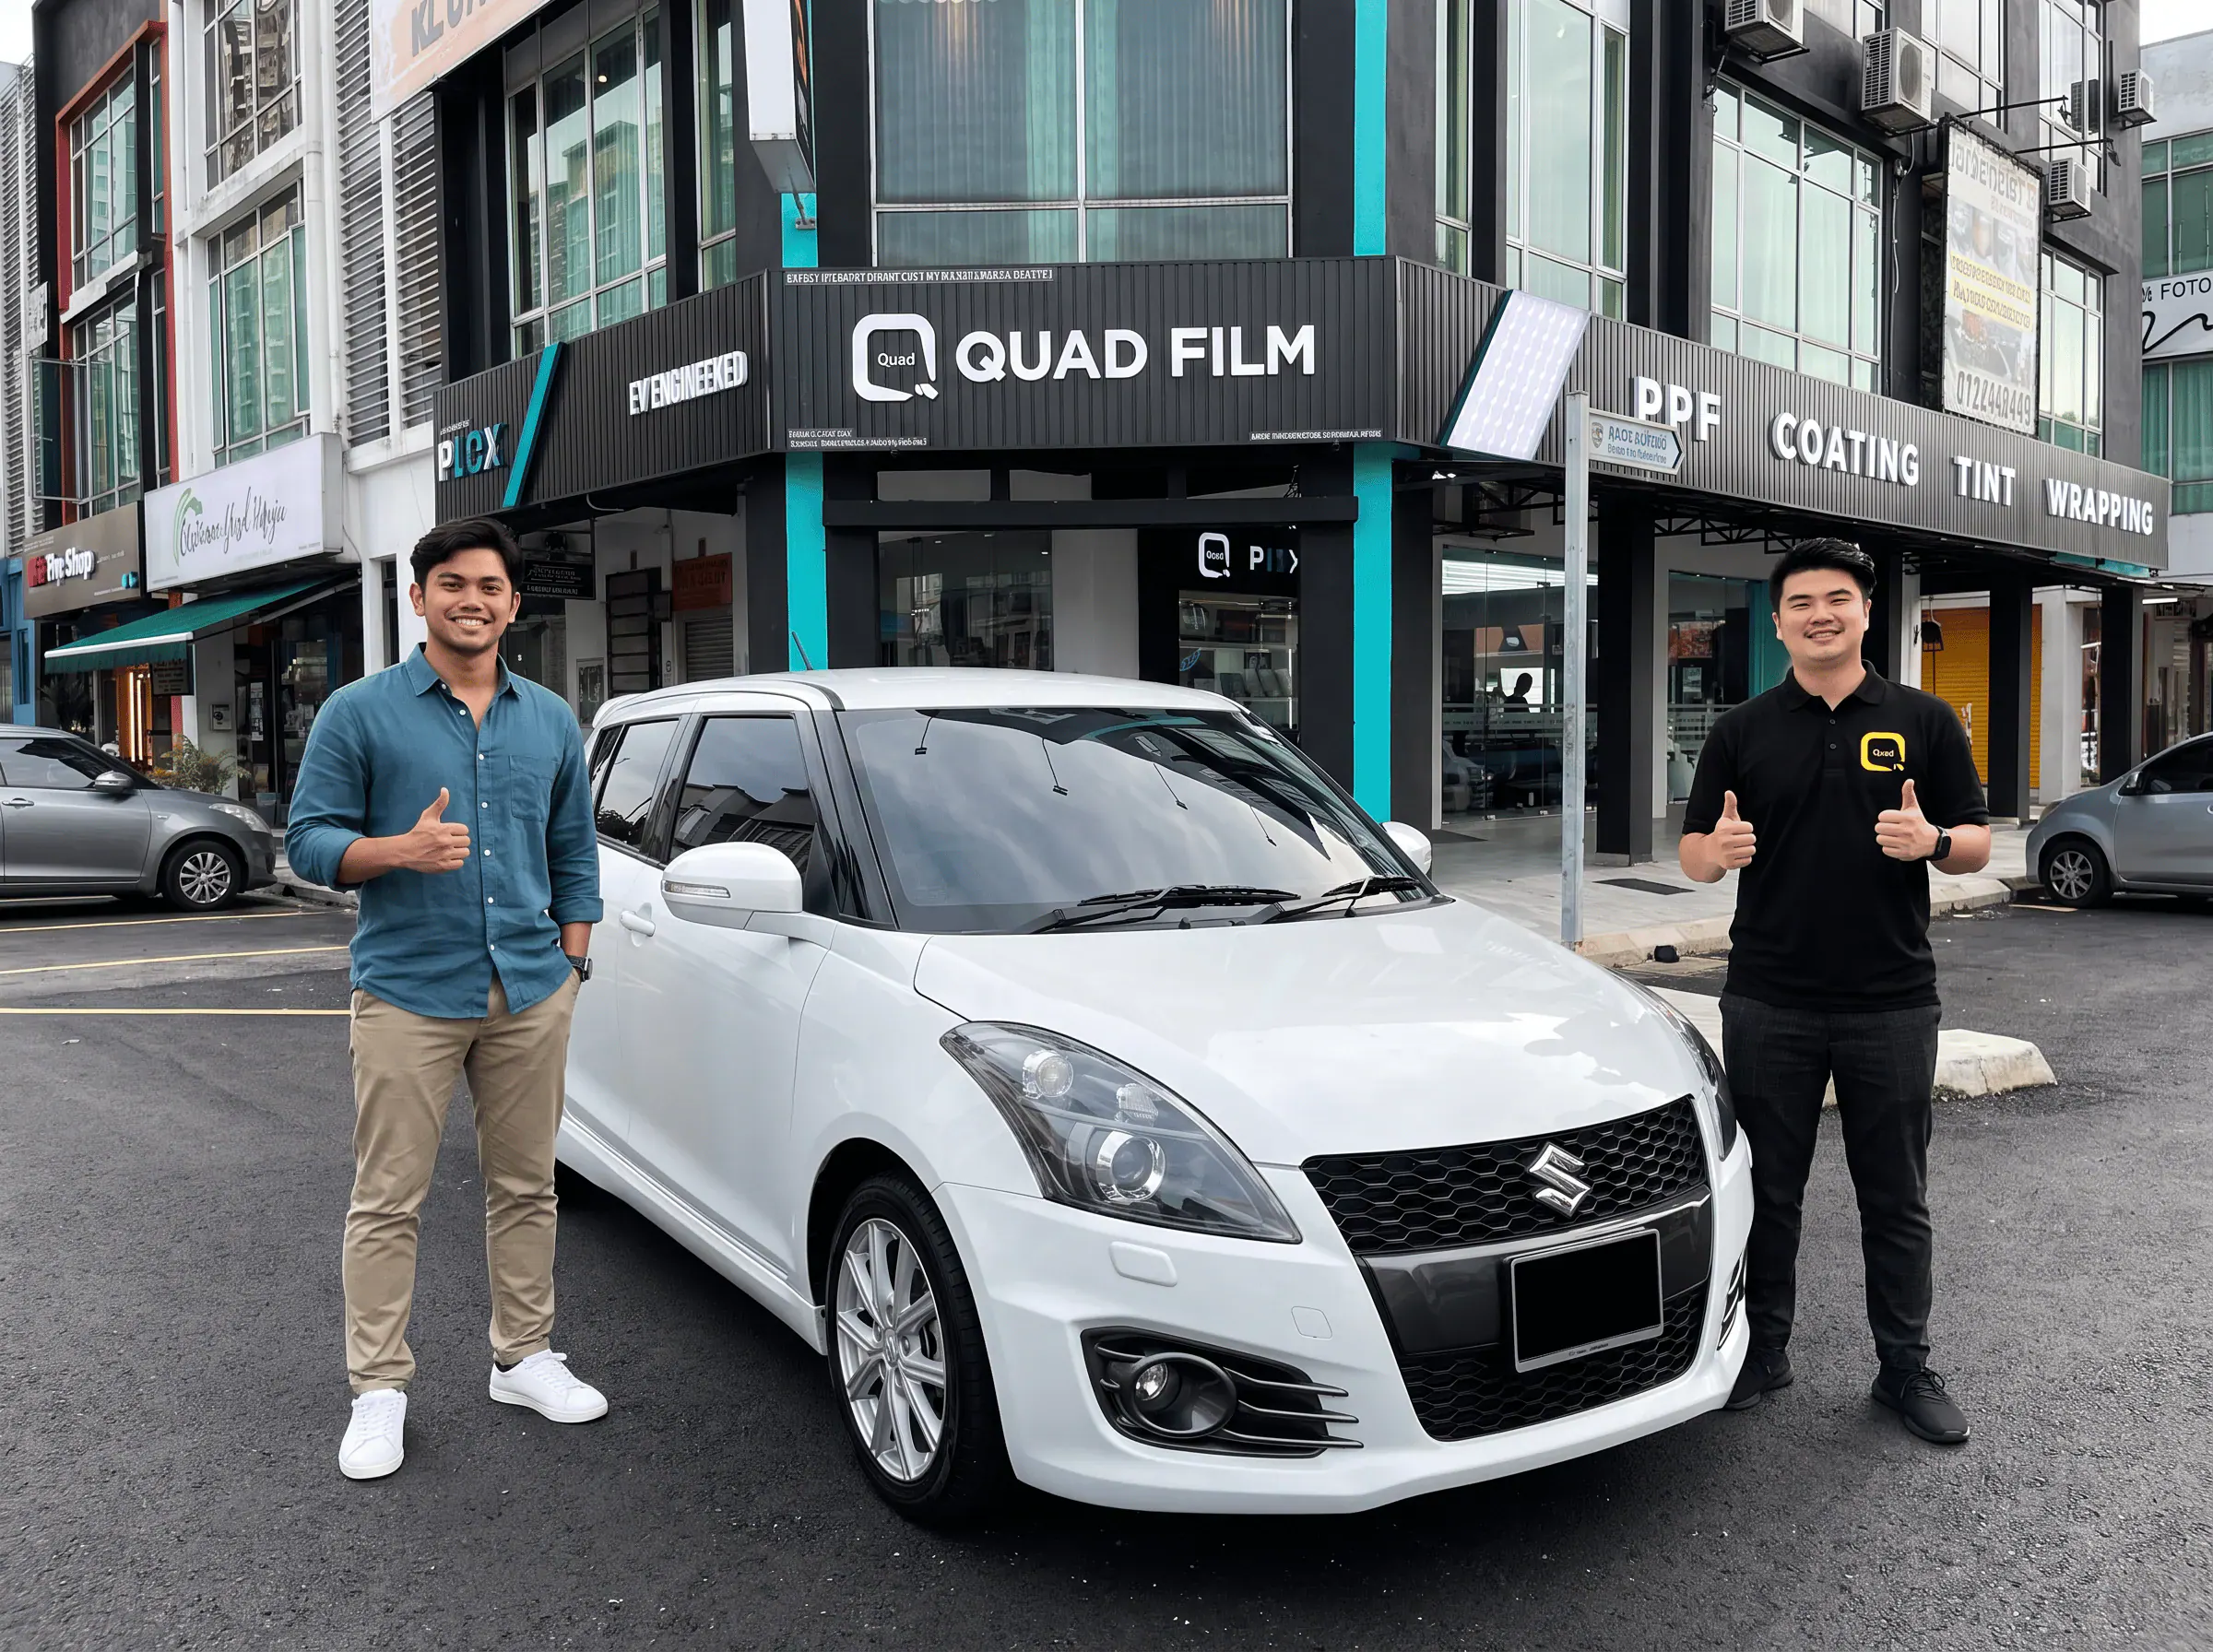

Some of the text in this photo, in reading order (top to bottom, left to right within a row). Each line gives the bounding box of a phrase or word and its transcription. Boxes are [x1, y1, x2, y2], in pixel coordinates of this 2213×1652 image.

[2160, 277, 2212, 301] FOTO
[877, 352, 916, 367] Quad
[955, 324, 1315, 383] QUAD FILM
[1634, 376, 2153, 536] PPF COATING TINT WRAPPING
[65, 547, 95, 580] Shop
